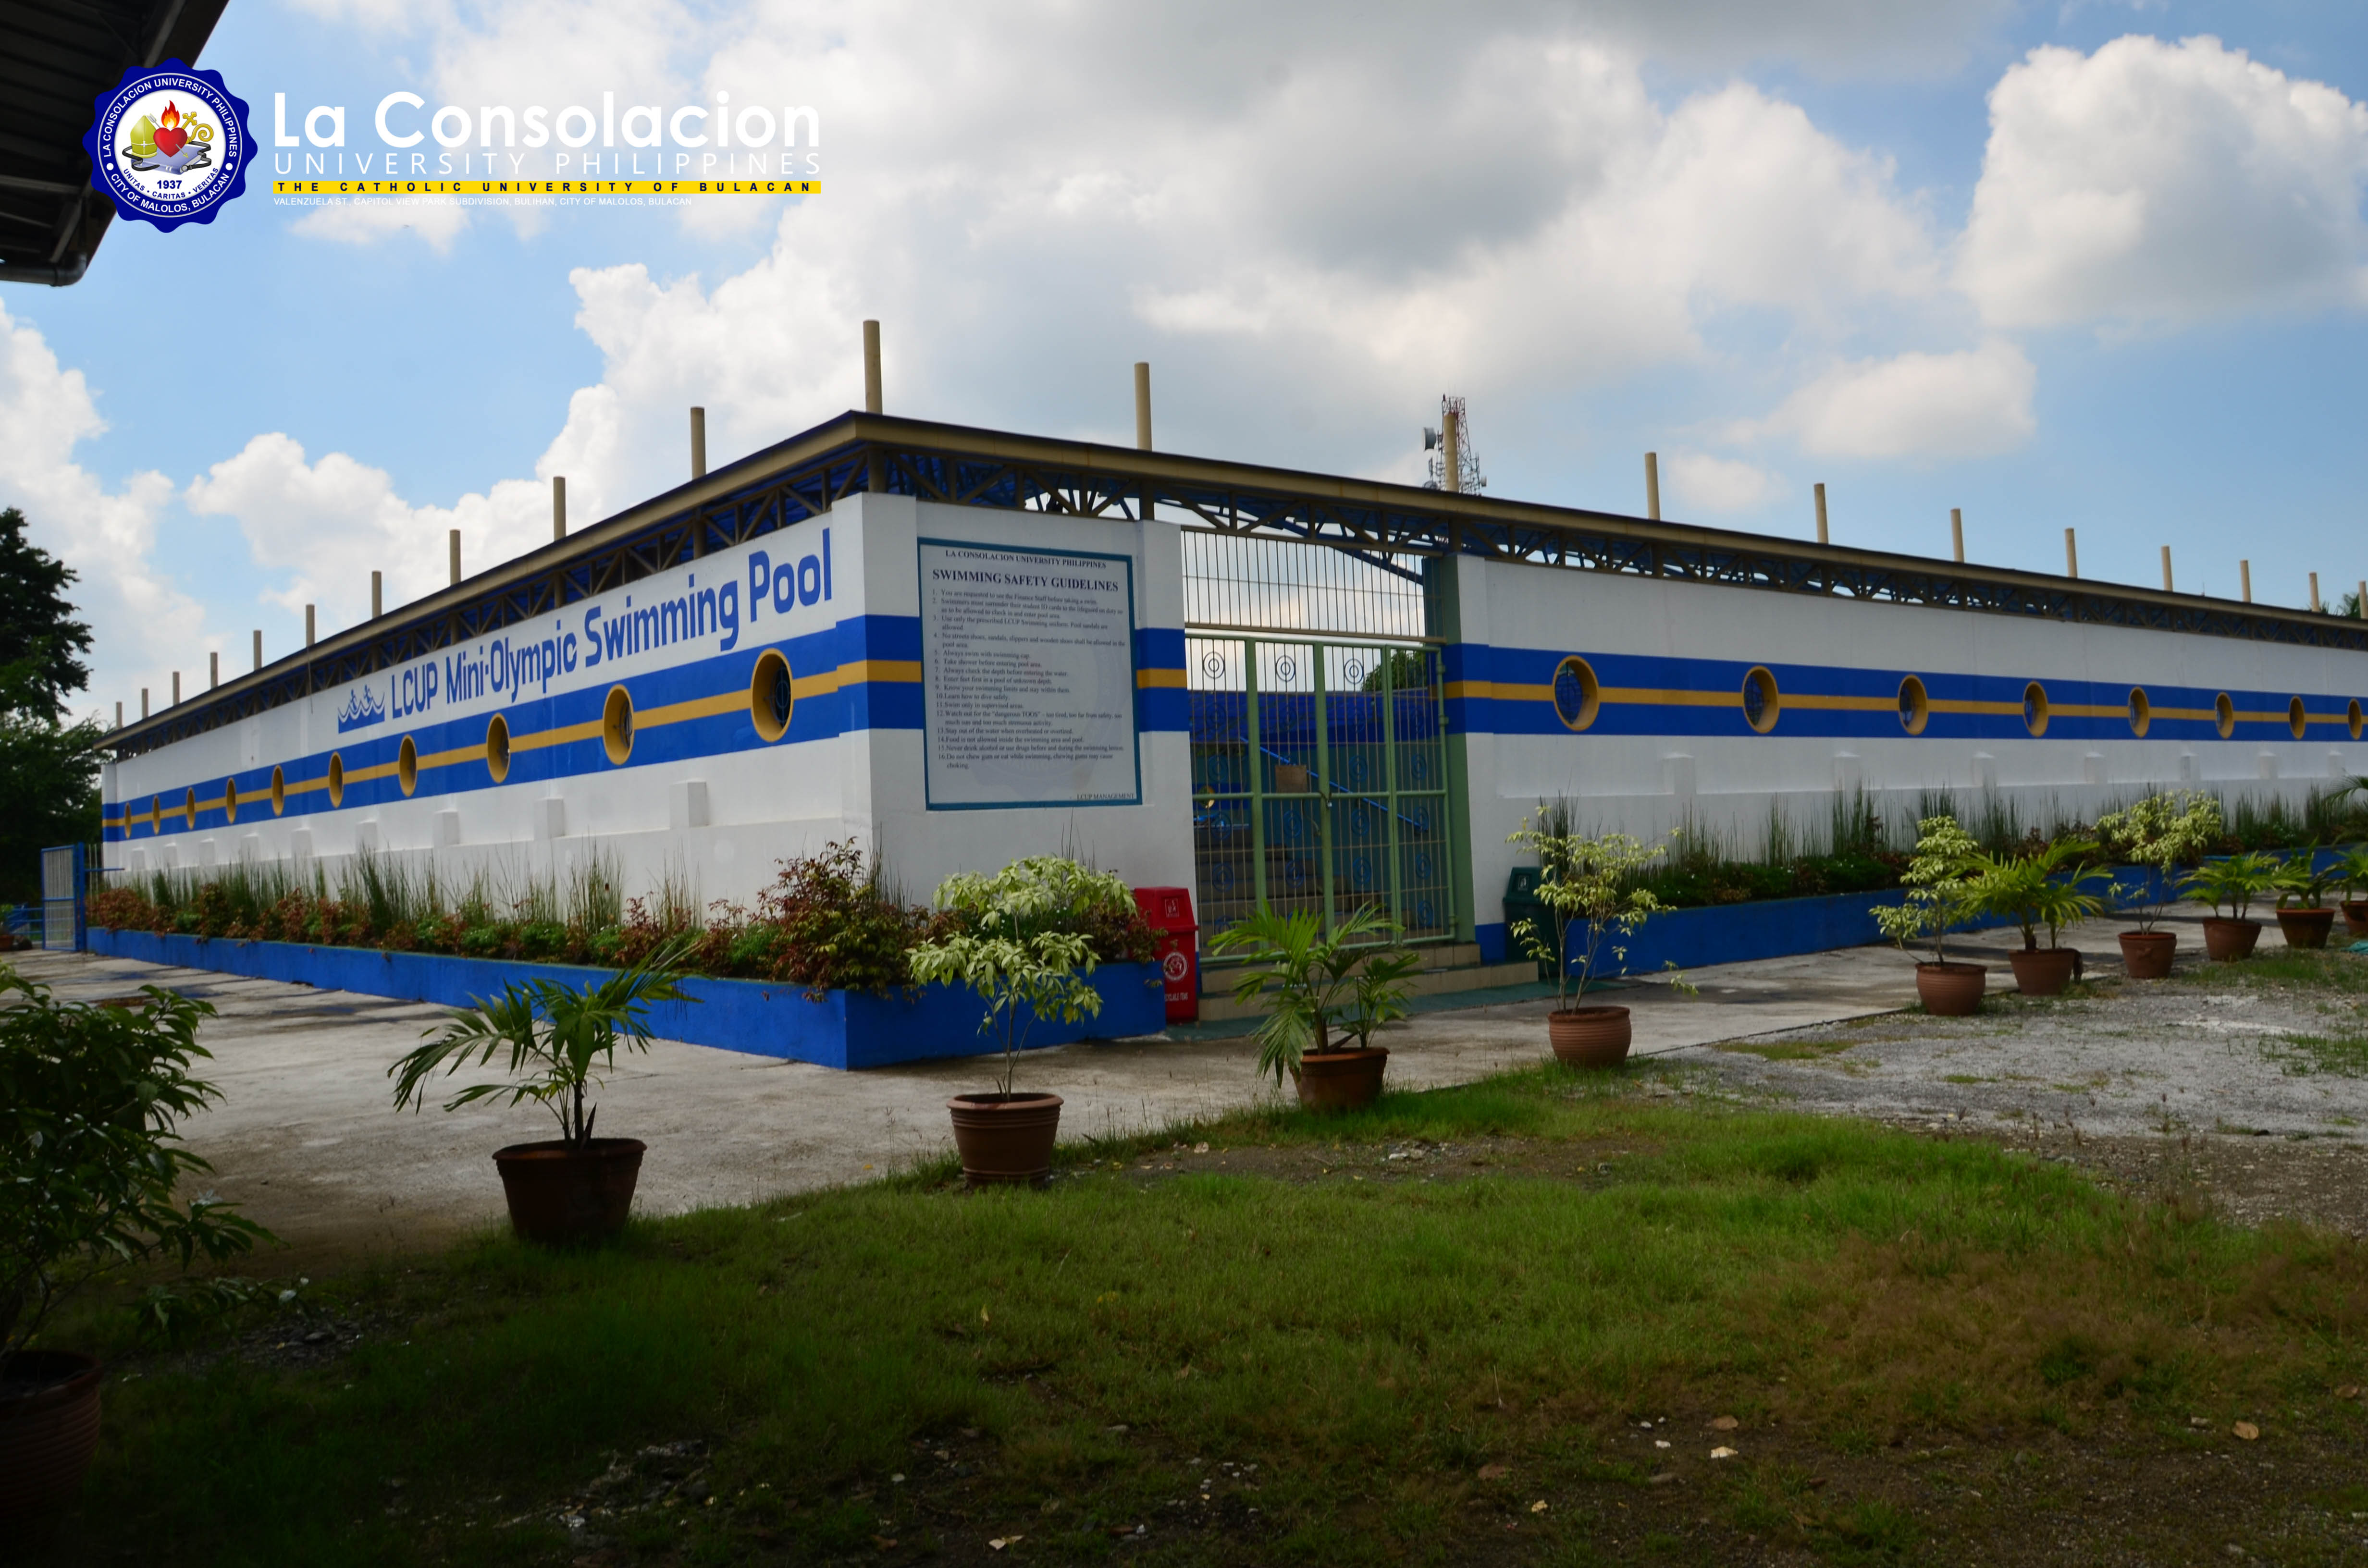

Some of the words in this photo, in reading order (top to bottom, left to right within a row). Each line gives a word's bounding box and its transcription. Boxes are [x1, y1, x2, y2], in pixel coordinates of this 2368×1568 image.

[958, 550, 1014, 562] CONSOLACION
[1016, 555, 1060, 565] UNIVERSITY
[1062, 559, 1106, 569] PHILIPPINES
[932, 568, 1001, 584] SWIMMING
[1004, 573, 1048, 587] SAFETY
[1050, 577, 1118, 592] GUIDELINES
[391, 662, 438, 719] LCUP
[446, 620, 577, 703] Mini-Olympic
[584, 573, 740, 668] Swimming
[749, 527, 832, 623] Pool
